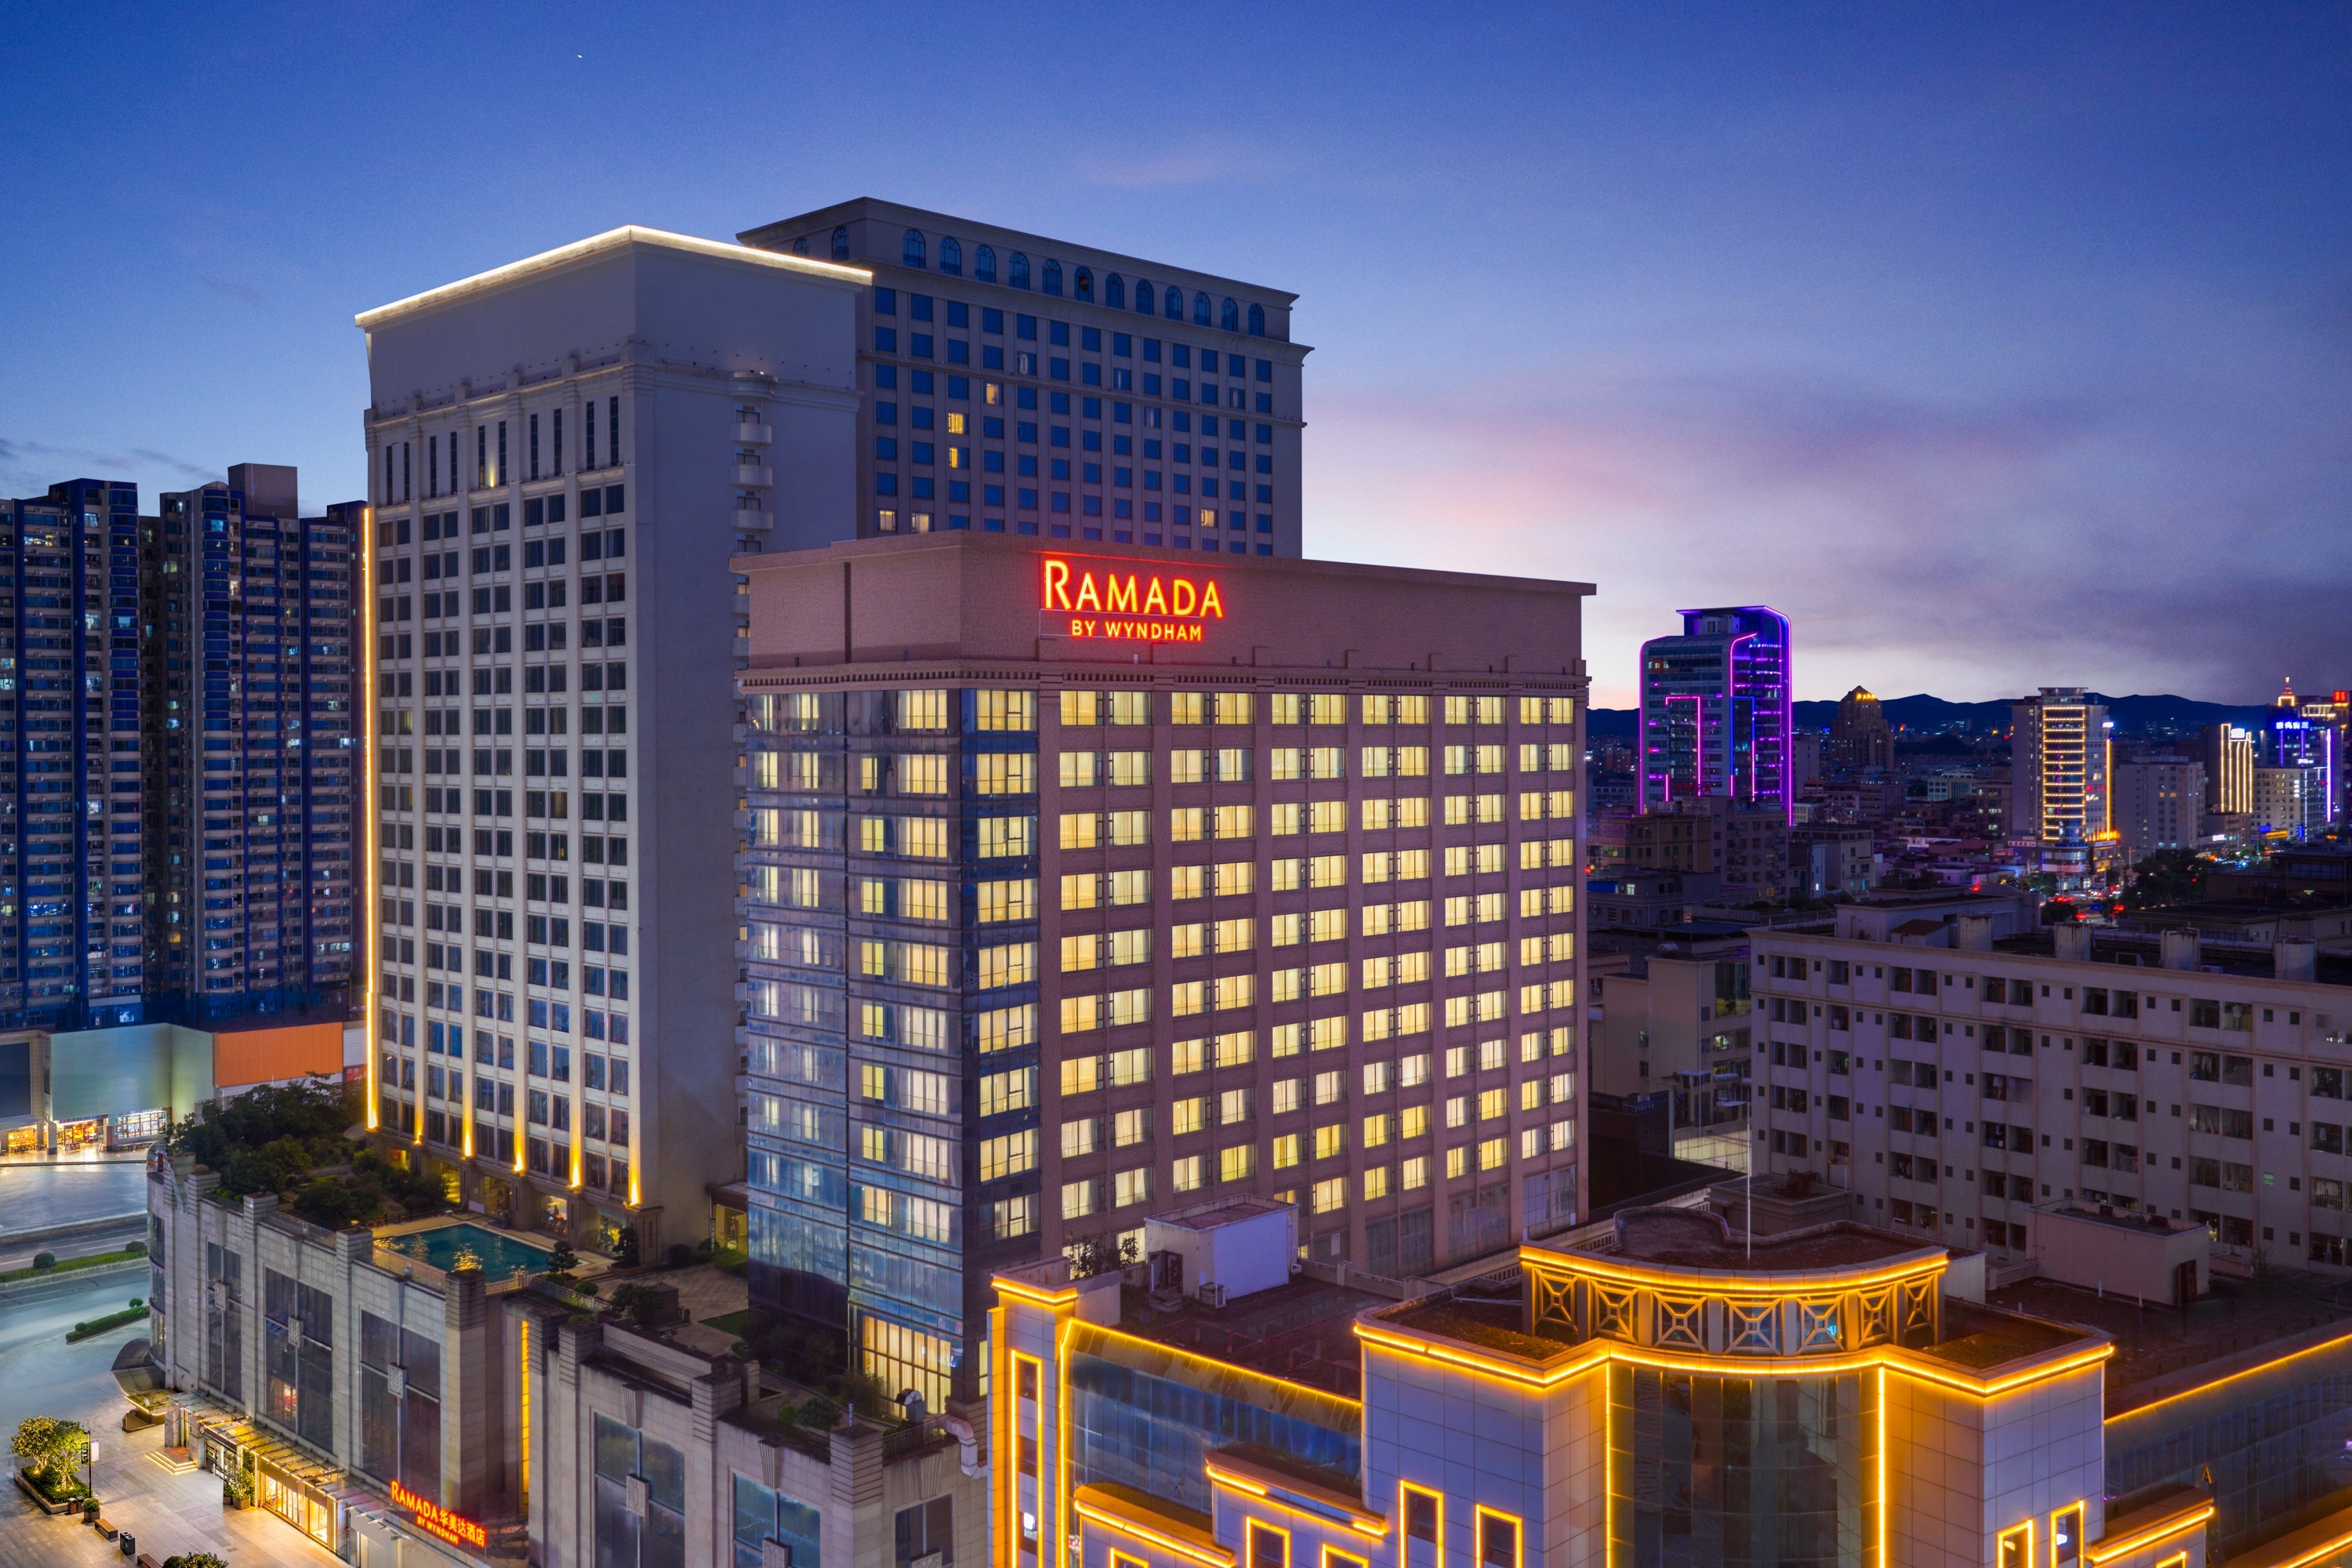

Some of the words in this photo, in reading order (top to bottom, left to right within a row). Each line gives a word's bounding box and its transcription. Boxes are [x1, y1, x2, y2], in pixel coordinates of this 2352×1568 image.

[1044, 559, 1223, 618] RAMADA
[1071, 619, 1096, 637] BY
[1105, 621, 1202, 641] WYNDHAM
[391, 1480, 439, 1523] RAMADA
[439, 1508, 486, 1548] 华美达酒店
[416, 1515, 426, 1526] BY
[426, 1520, 459, 1545] WYNDHAM
